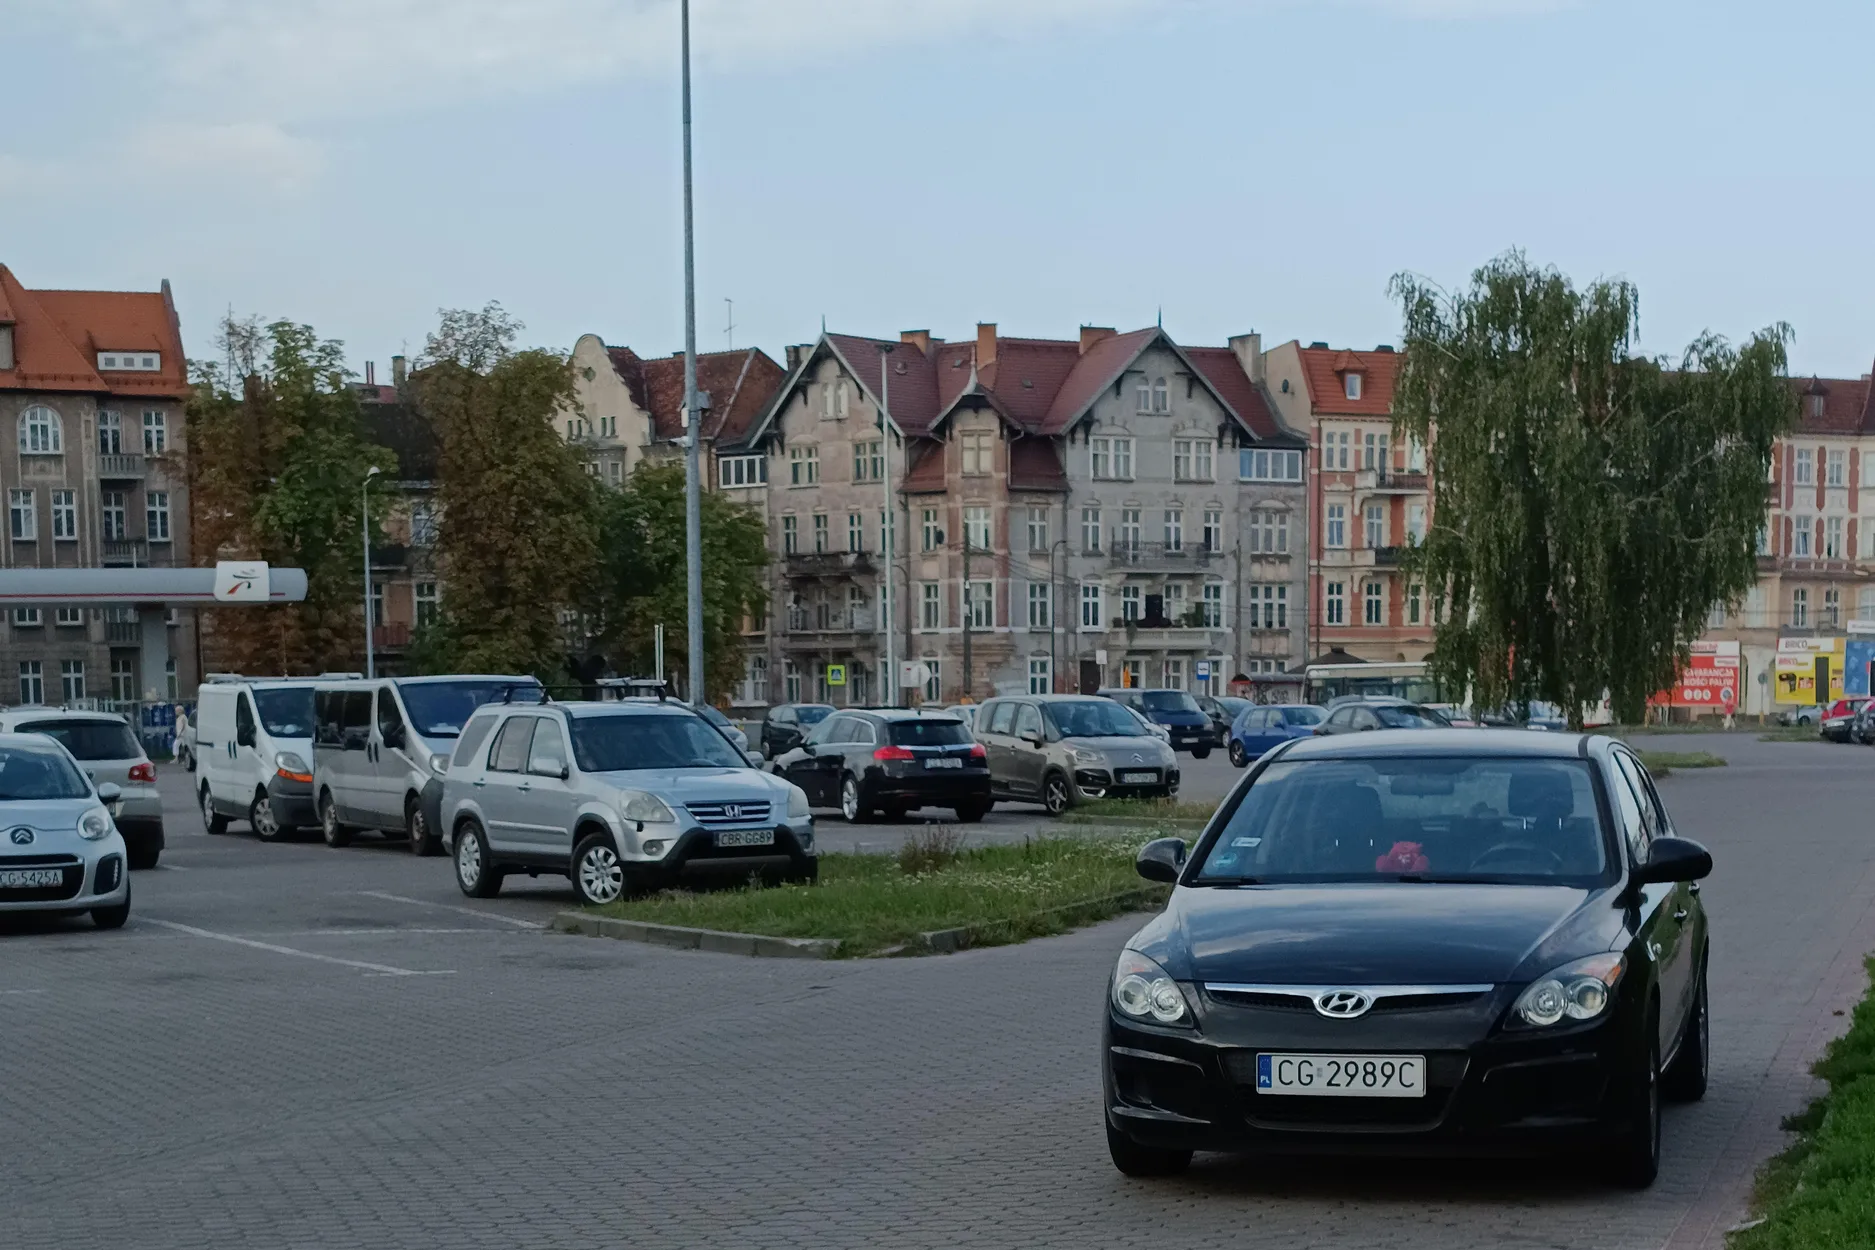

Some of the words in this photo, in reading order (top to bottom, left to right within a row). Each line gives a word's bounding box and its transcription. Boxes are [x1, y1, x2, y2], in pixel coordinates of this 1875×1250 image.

[21, 871, 60, 885] 5425A
[1260, 1076, 1270, 1084] PL
[1278, 1059, 1314, 1086] CG
[1326, 1060, 1415, 1088] 2989C
